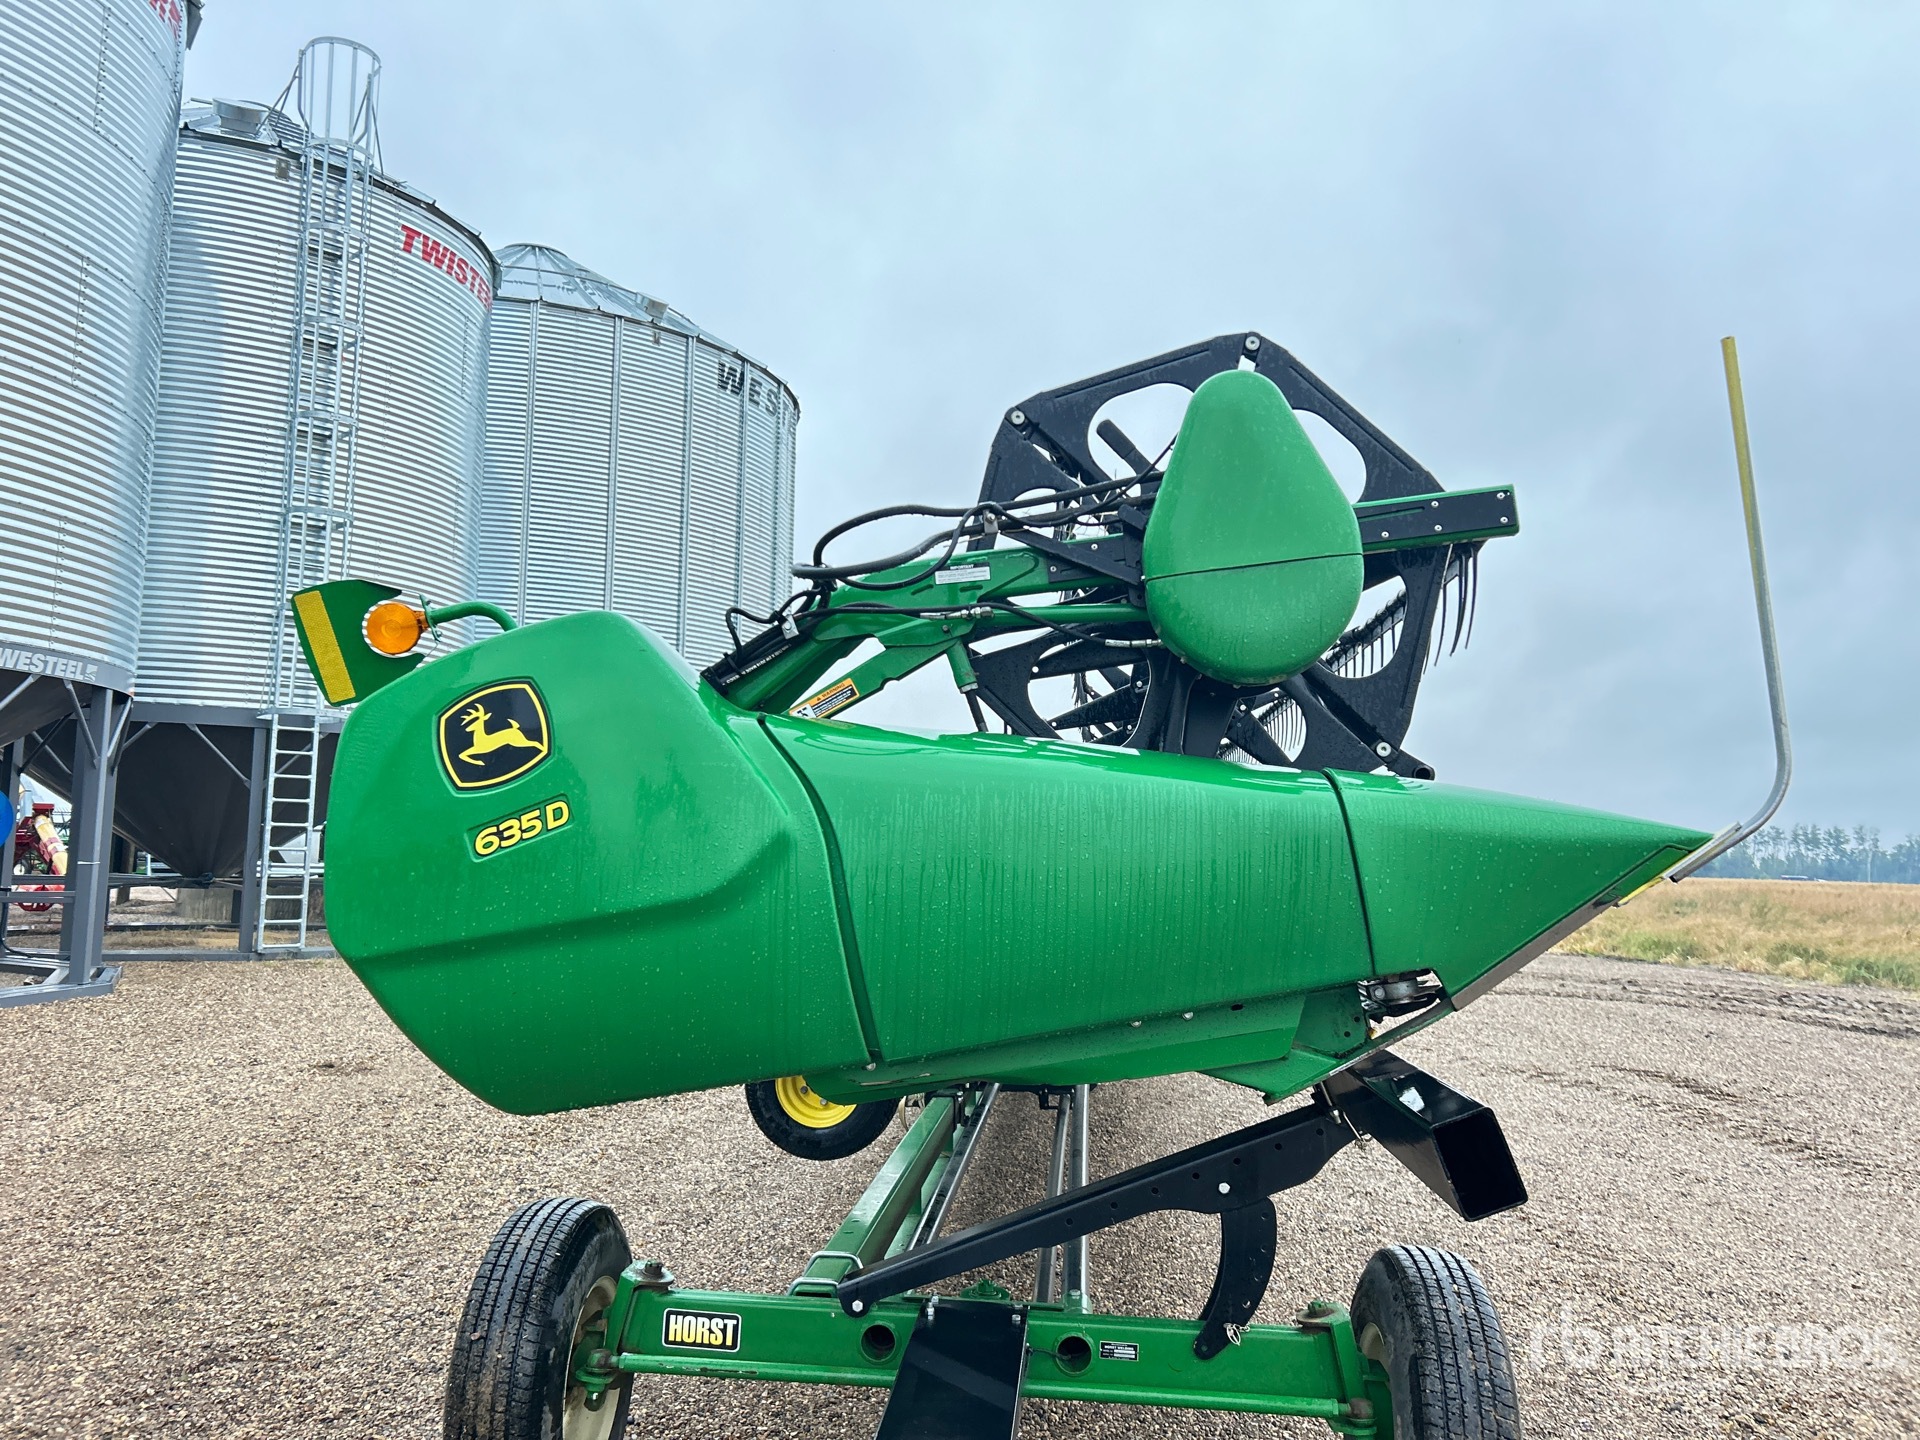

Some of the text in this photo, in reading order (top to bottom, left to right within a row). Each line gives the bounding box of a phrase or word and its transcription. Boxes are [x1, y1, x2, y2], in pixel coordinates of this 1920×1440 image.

[0, 648, 84, 680] WESTEEL
[474, 800, 570, 856] 635D
[668, 1314, 737, 1346] HORST
